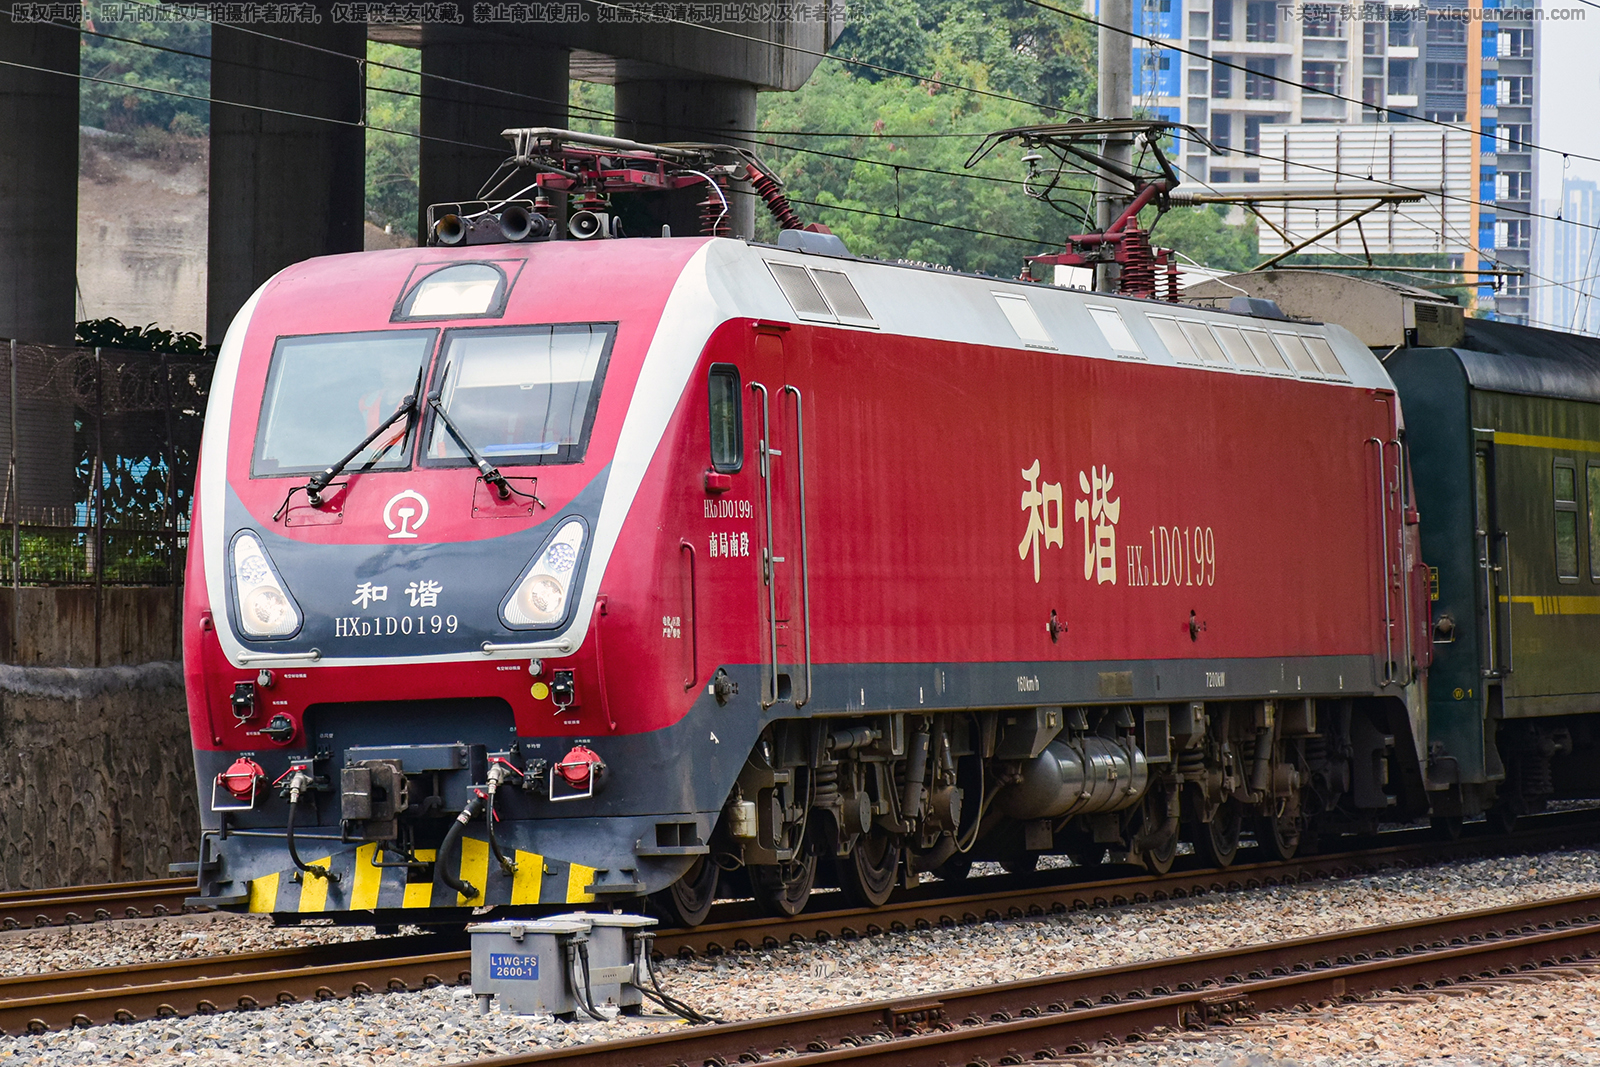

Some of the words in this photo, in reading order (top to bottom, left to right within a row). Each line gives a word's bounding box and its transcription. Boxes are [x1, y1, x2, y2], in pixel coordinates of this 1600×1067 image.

[1018, 458, 1121, 586] 和谐
[708, 531, 749, 558] 南局南段
[491, 956, 537, 967] L1WG-FS
[496, 967, 532, 977] 2600-1
